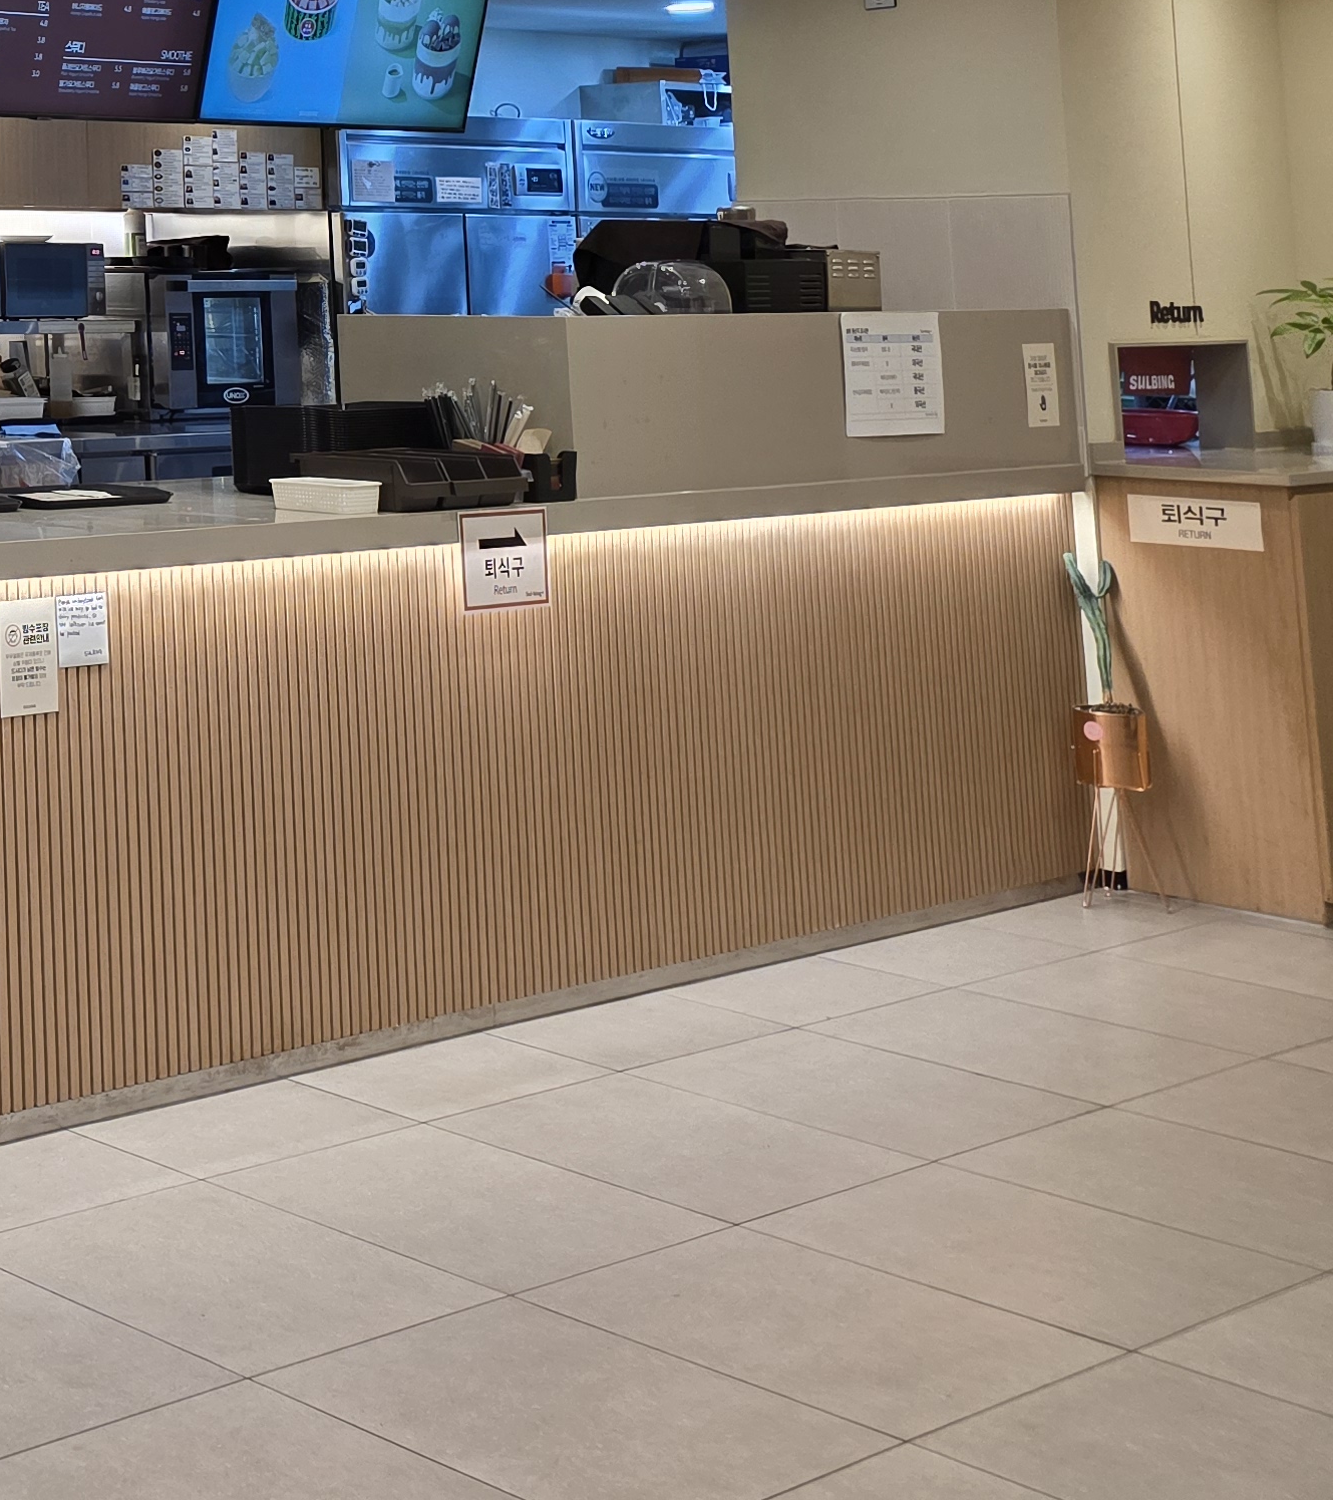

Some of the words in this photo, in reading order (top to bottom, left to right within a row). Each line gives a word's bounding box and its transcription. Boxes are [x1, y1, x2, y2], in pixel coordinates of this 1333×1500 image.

[37, 0, 50, 12] TEA
[64, 40, 86, 54] 스무디
[1149, 301, 1204, 324] Return
[1129, 374, 1176, 390] SULBING
[1161, 503, 1228, 527] 퇴식구
[1178, 529, 1212, 540] RETURN
[485, 556, 525, 579] 퇴식구
[493, 585, 518, 596] Return
